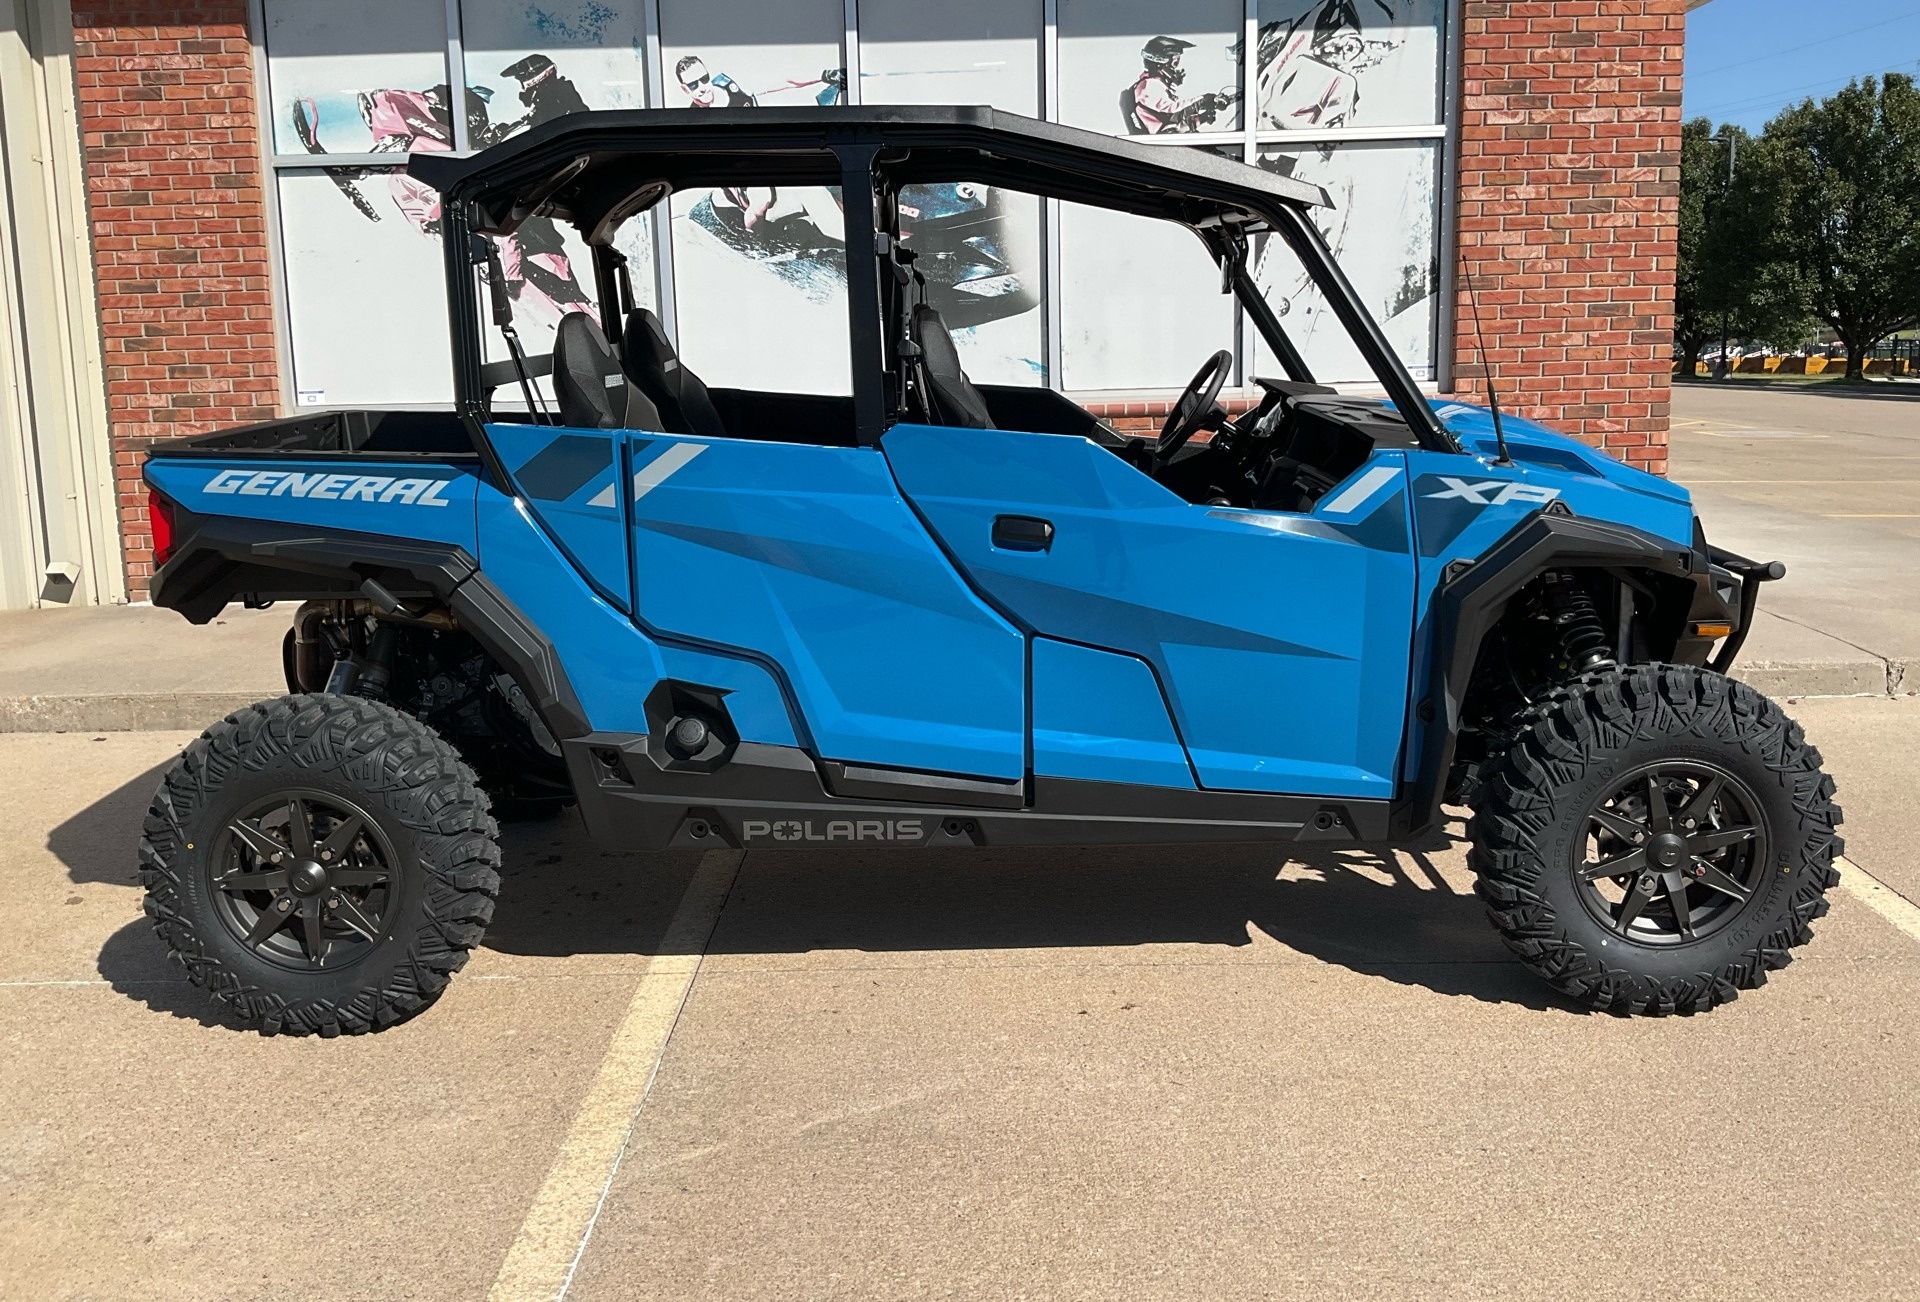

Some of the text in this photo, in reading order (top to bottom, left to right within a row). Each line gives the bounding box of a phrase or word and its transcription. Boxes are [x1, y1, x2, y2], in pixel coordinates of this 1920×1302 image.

[202, 469, 451, 507] GENERAL
[1418, 476, 1562, 505] XP
[742, 820, 924, 841] POLARIS
